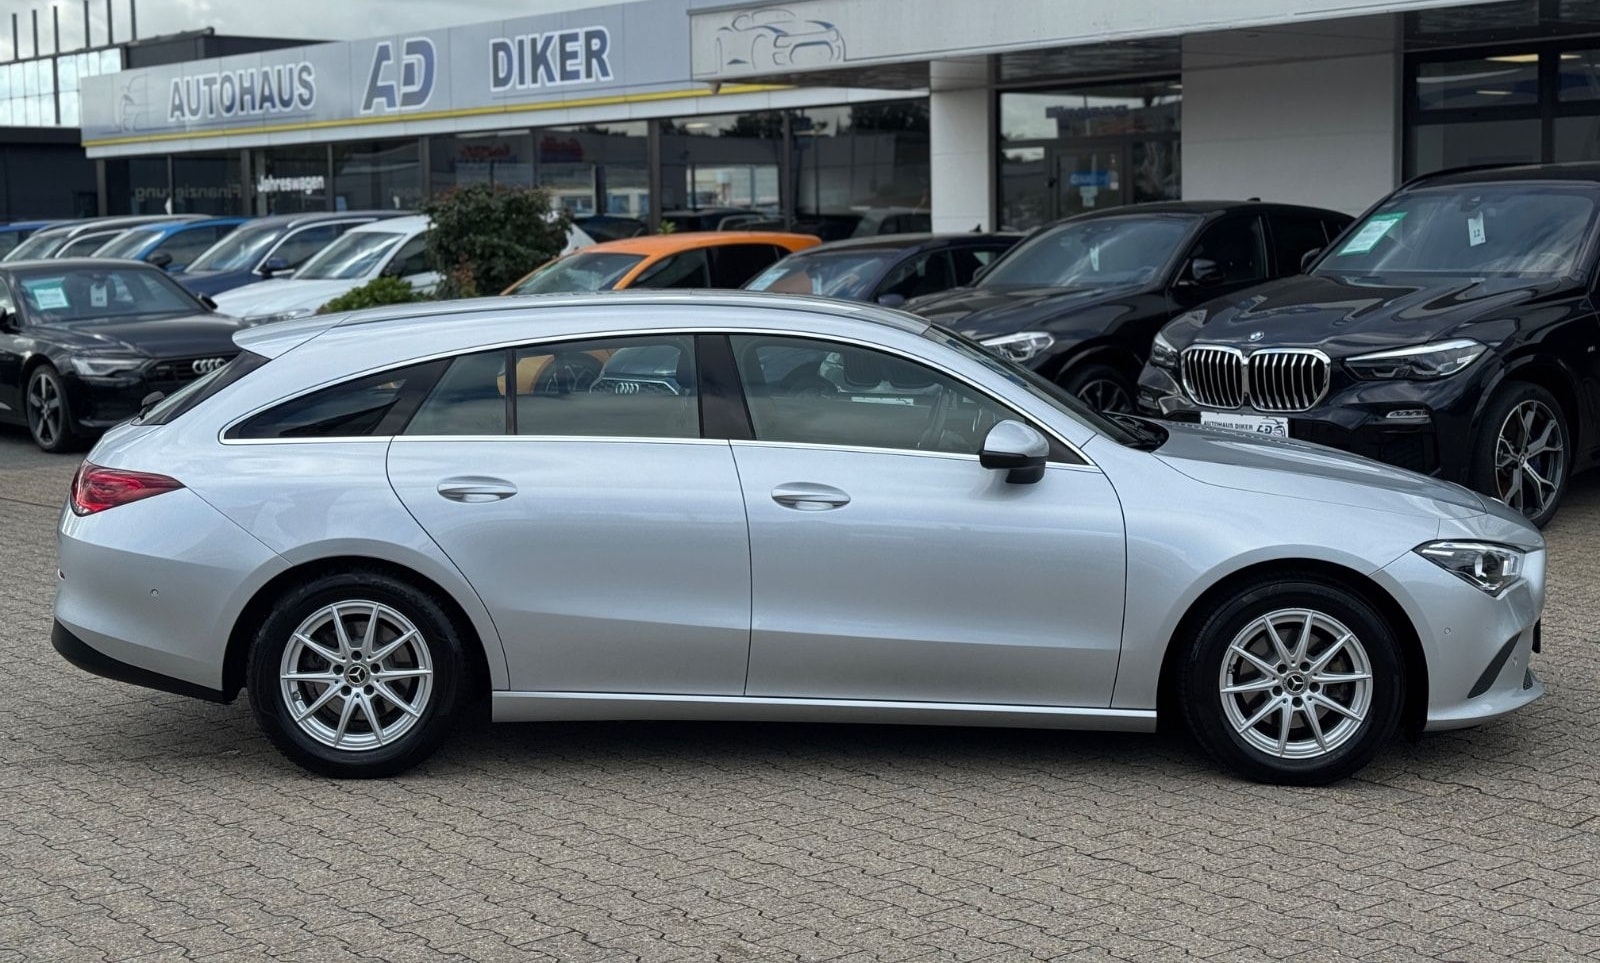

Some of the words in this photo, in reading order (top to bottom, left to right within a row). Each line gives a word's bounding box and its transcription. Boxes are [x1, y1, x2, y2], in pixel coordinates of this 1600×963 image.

[168, 61, 316, 122] AUTOHAUS
[360, 36, 436, 114] AD
[489, 26, 613, 92] DIKER
[257, 174, 324, 194] Jahreswagen
